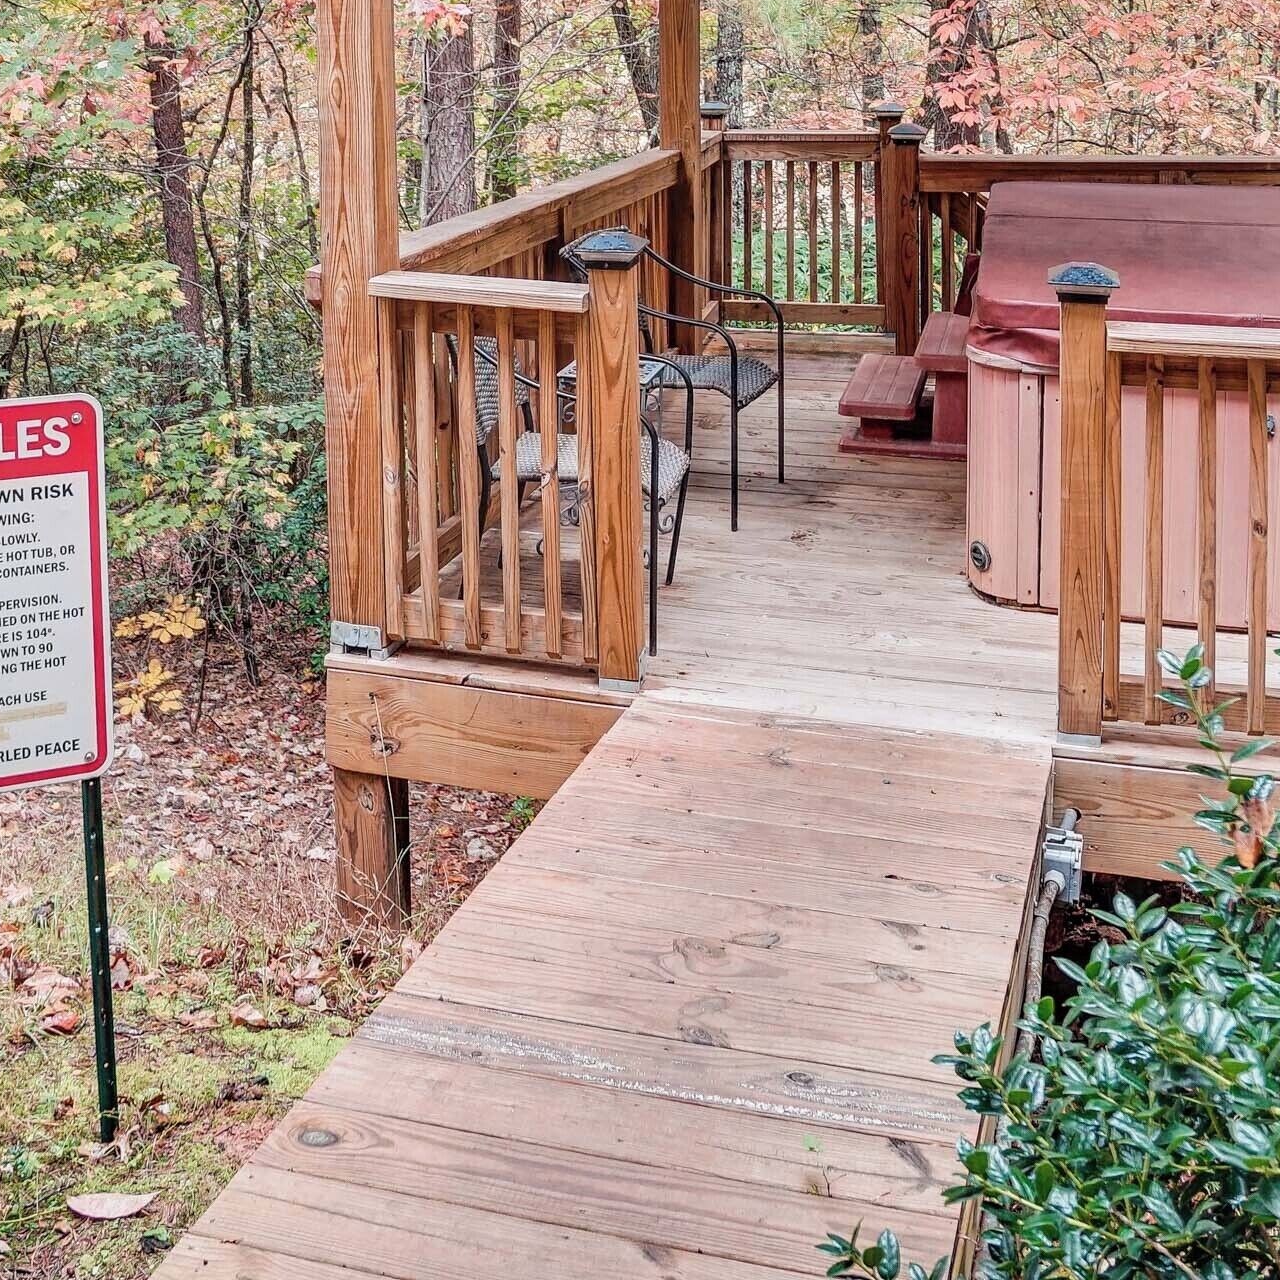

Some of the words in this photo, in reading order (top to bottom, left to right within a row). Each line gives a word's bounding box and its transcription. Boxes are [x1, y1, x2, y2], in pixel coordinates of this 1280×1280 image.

[31, 482, 74, 501] RISK
[6, 549, 29, 562] HOT
[30, 547, 56, 559] TUB,
[60, 544, 75, 556] OR
[20, 613, 36, 625] ON
[38, 609, 61, 622] THE
[63, 606, 85, 619] HOT
[12, 630, 23, 642] IS
[21, 645, 36, 656] TO
[38, 642, 53, 654] 90
[19, 659, 42, 672] THE
[44, 656, 67, 668] HOT
[24, 690, 47, 703] USE
[35, 738, 80, 757] PEACE
